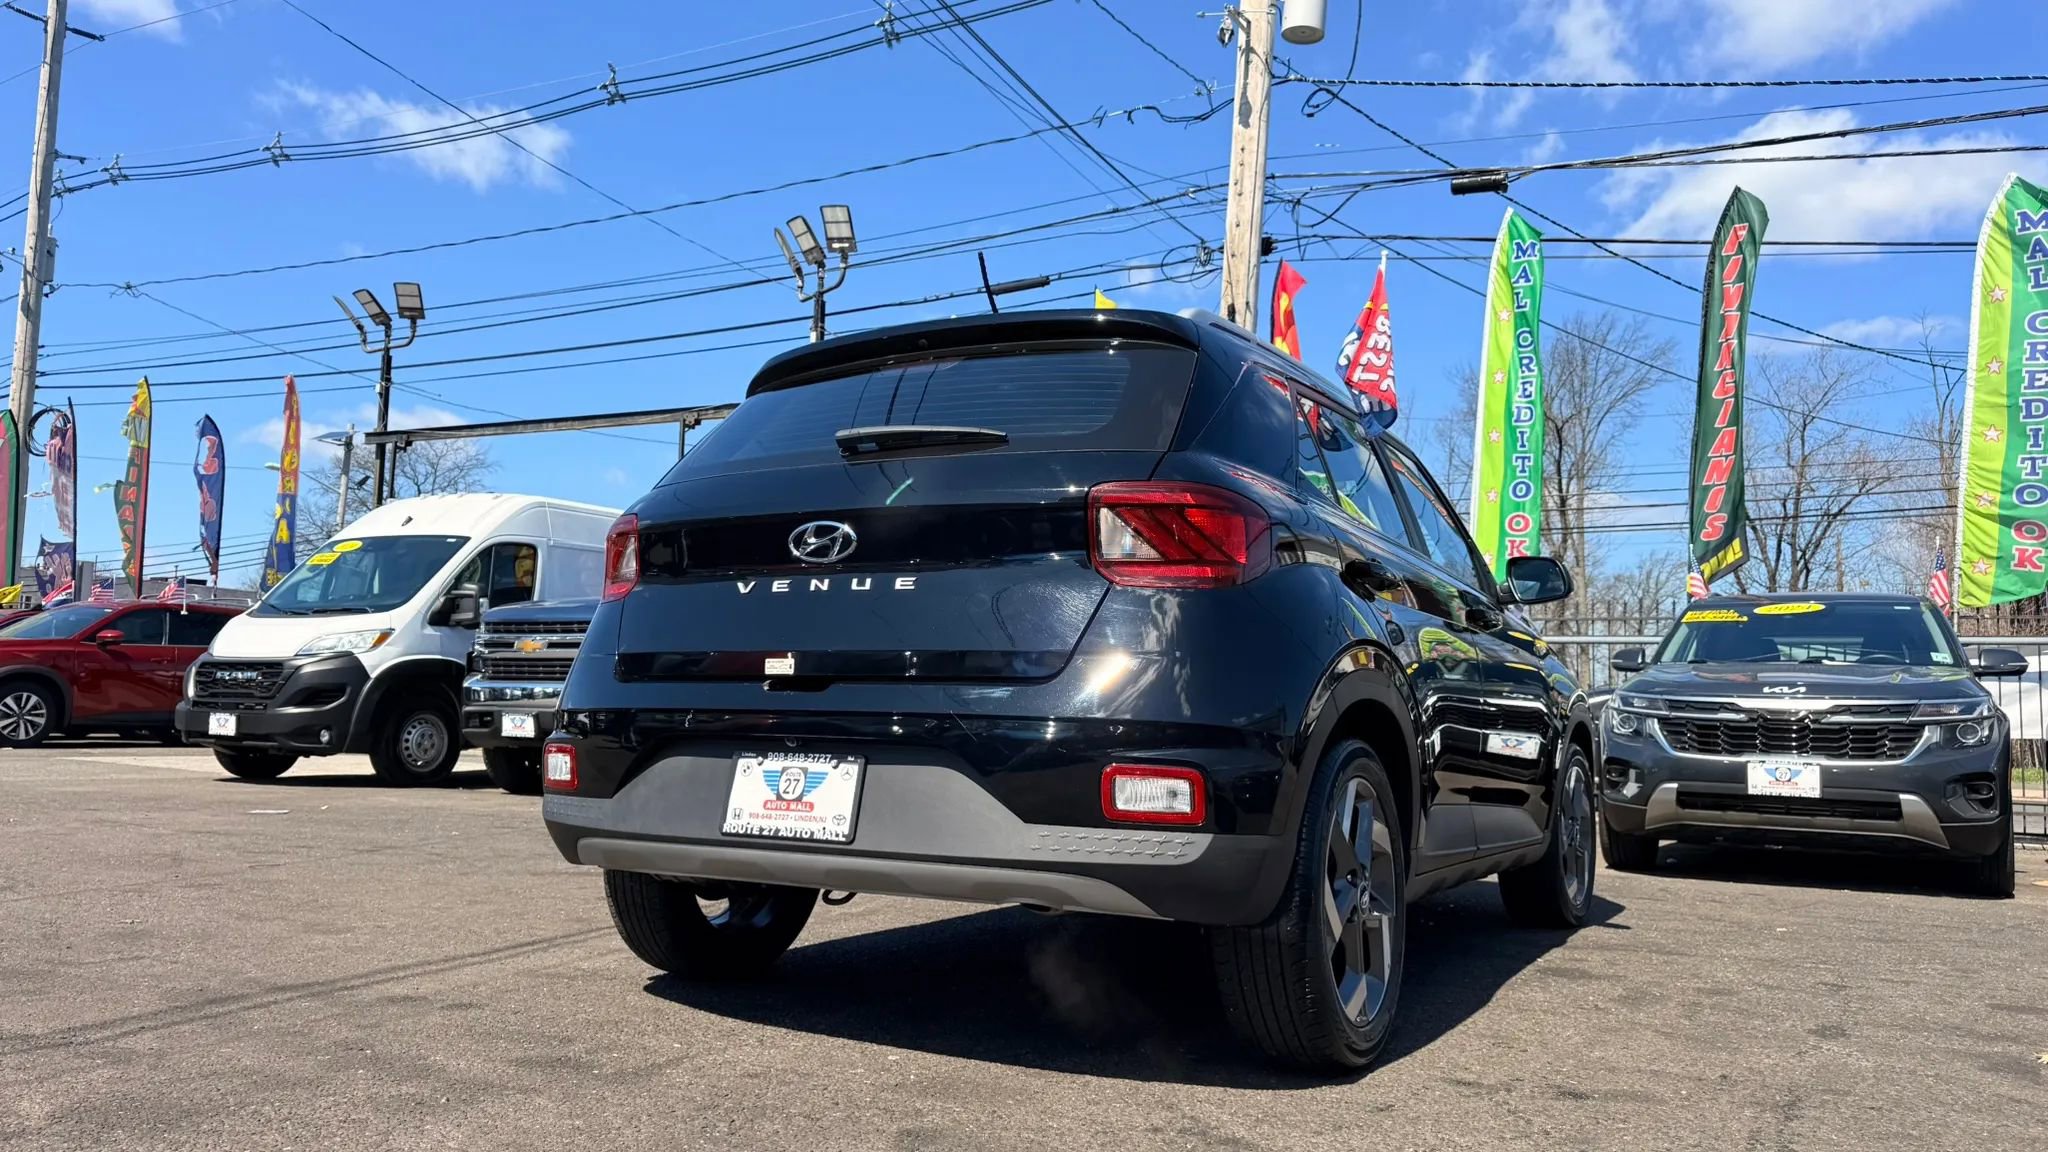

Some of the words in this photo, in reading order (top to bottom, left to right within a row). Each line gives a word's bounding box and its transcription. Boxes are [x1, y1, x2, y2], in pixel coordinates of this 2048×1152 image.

[2014, 208, 2048, 292] MAL
[1512, 238, 1540, 311] MAL
[1511, 327, 1537, 502] CREDITO
[2012, 310, 2048, 508] CREDITO
[1505, 512, 1533, 559] OK
[2011, 519, 2048, 574] OK
[737, 576, 919, 595] VENUE
[767, 752, 832, 765] 908-648-2727
[765, 801, 787, 810] AUTO
[789, 801, 812, 812] MALL
[782, 778, 800, 795] 27
[722, 822, 761, 835] ROUTE
[761, 824, 778, 836] 27
[777, 825, 812, 839] AUTO
[812, 827, 846, 842] MALL
